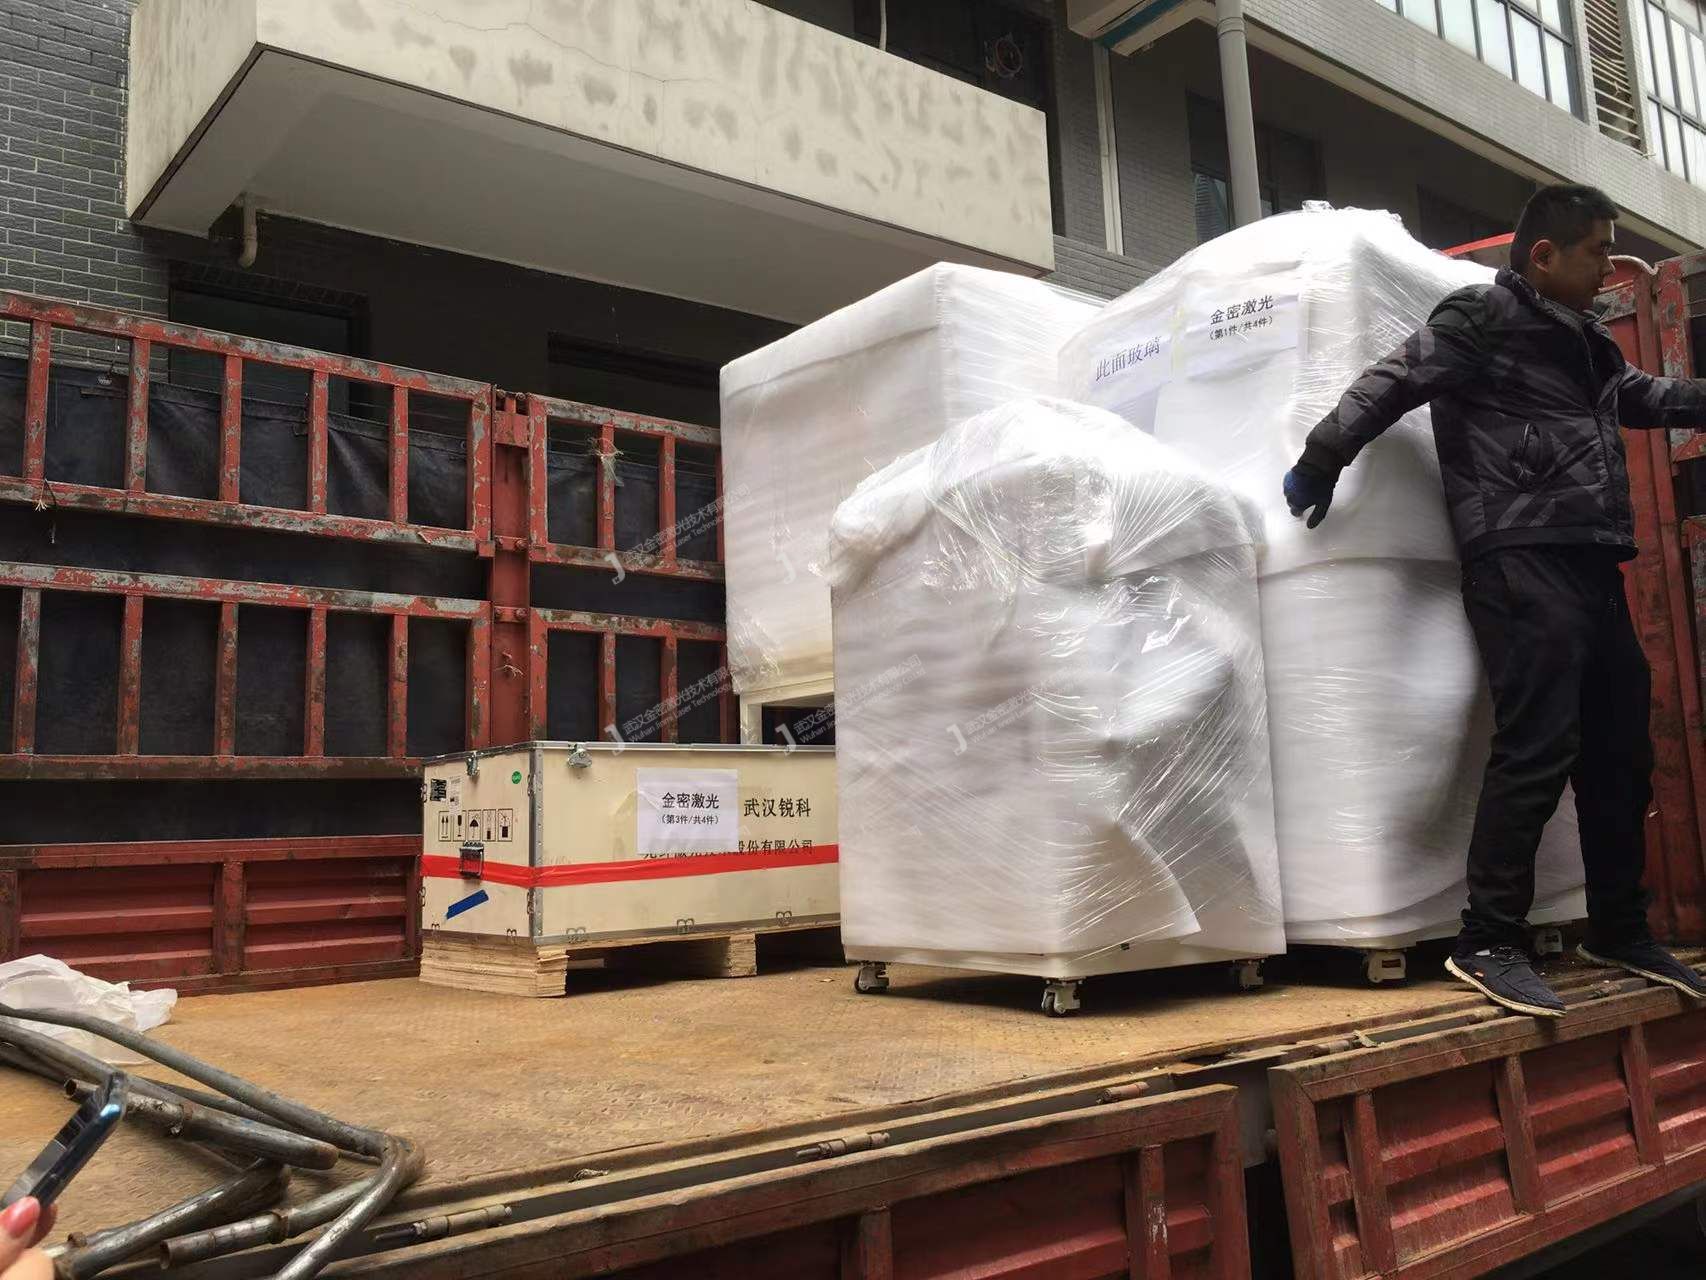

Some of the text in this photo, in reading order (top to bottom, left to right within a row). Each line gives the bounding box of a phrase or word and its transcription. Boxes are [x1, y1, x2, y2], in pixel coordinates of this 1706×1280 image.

[1210, 295, 1273, 325] 金密激光
[1096, 336, 1161, 381] 此面玻璃
[662, 792, 720, 809] 金密激光
[744, 798, 812, 817] 武汉锐科
